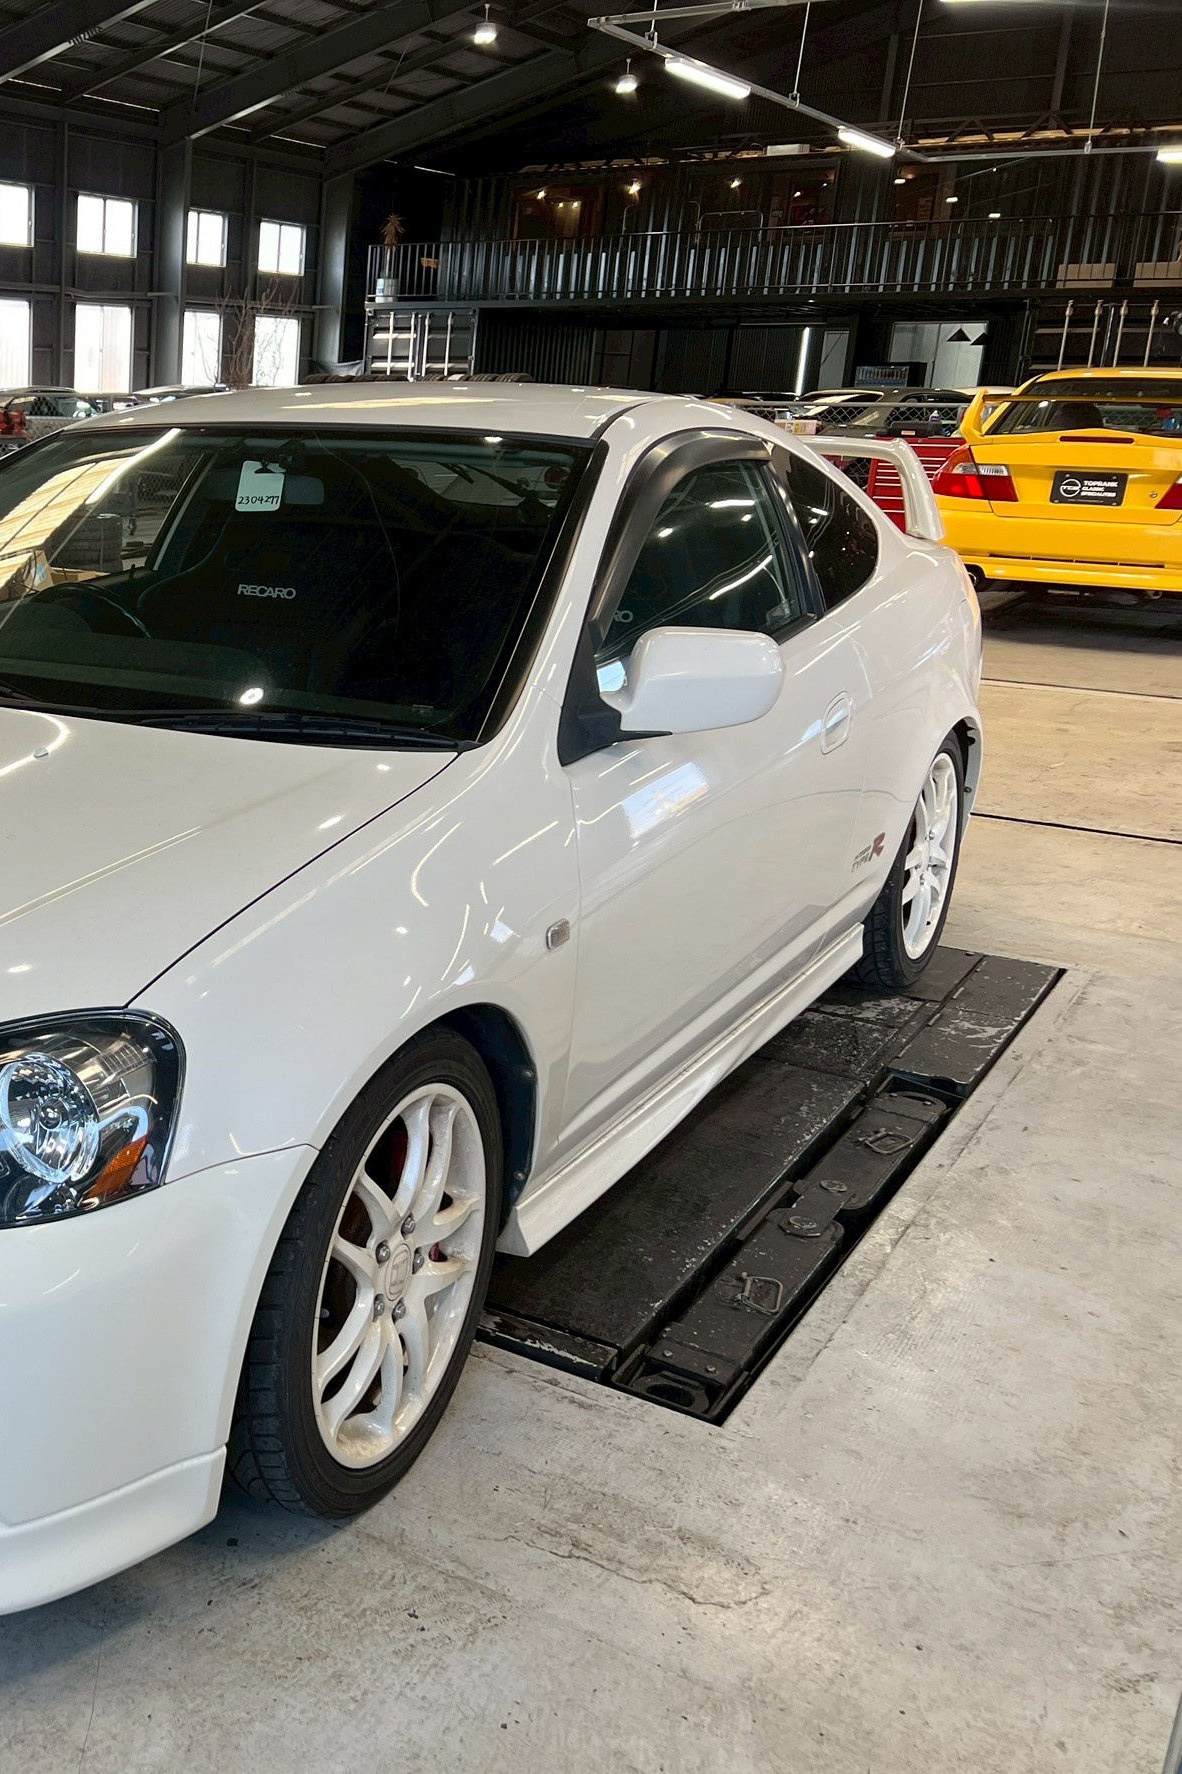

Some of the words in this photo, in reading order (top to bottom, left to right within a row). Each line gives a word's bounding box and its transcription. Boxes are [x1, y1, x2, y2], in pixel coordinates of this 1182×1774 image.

[238, 495, 280, 505] 2304277
[237, 583, 297, 600] RECARO
[868, 831, 886, 862] R
